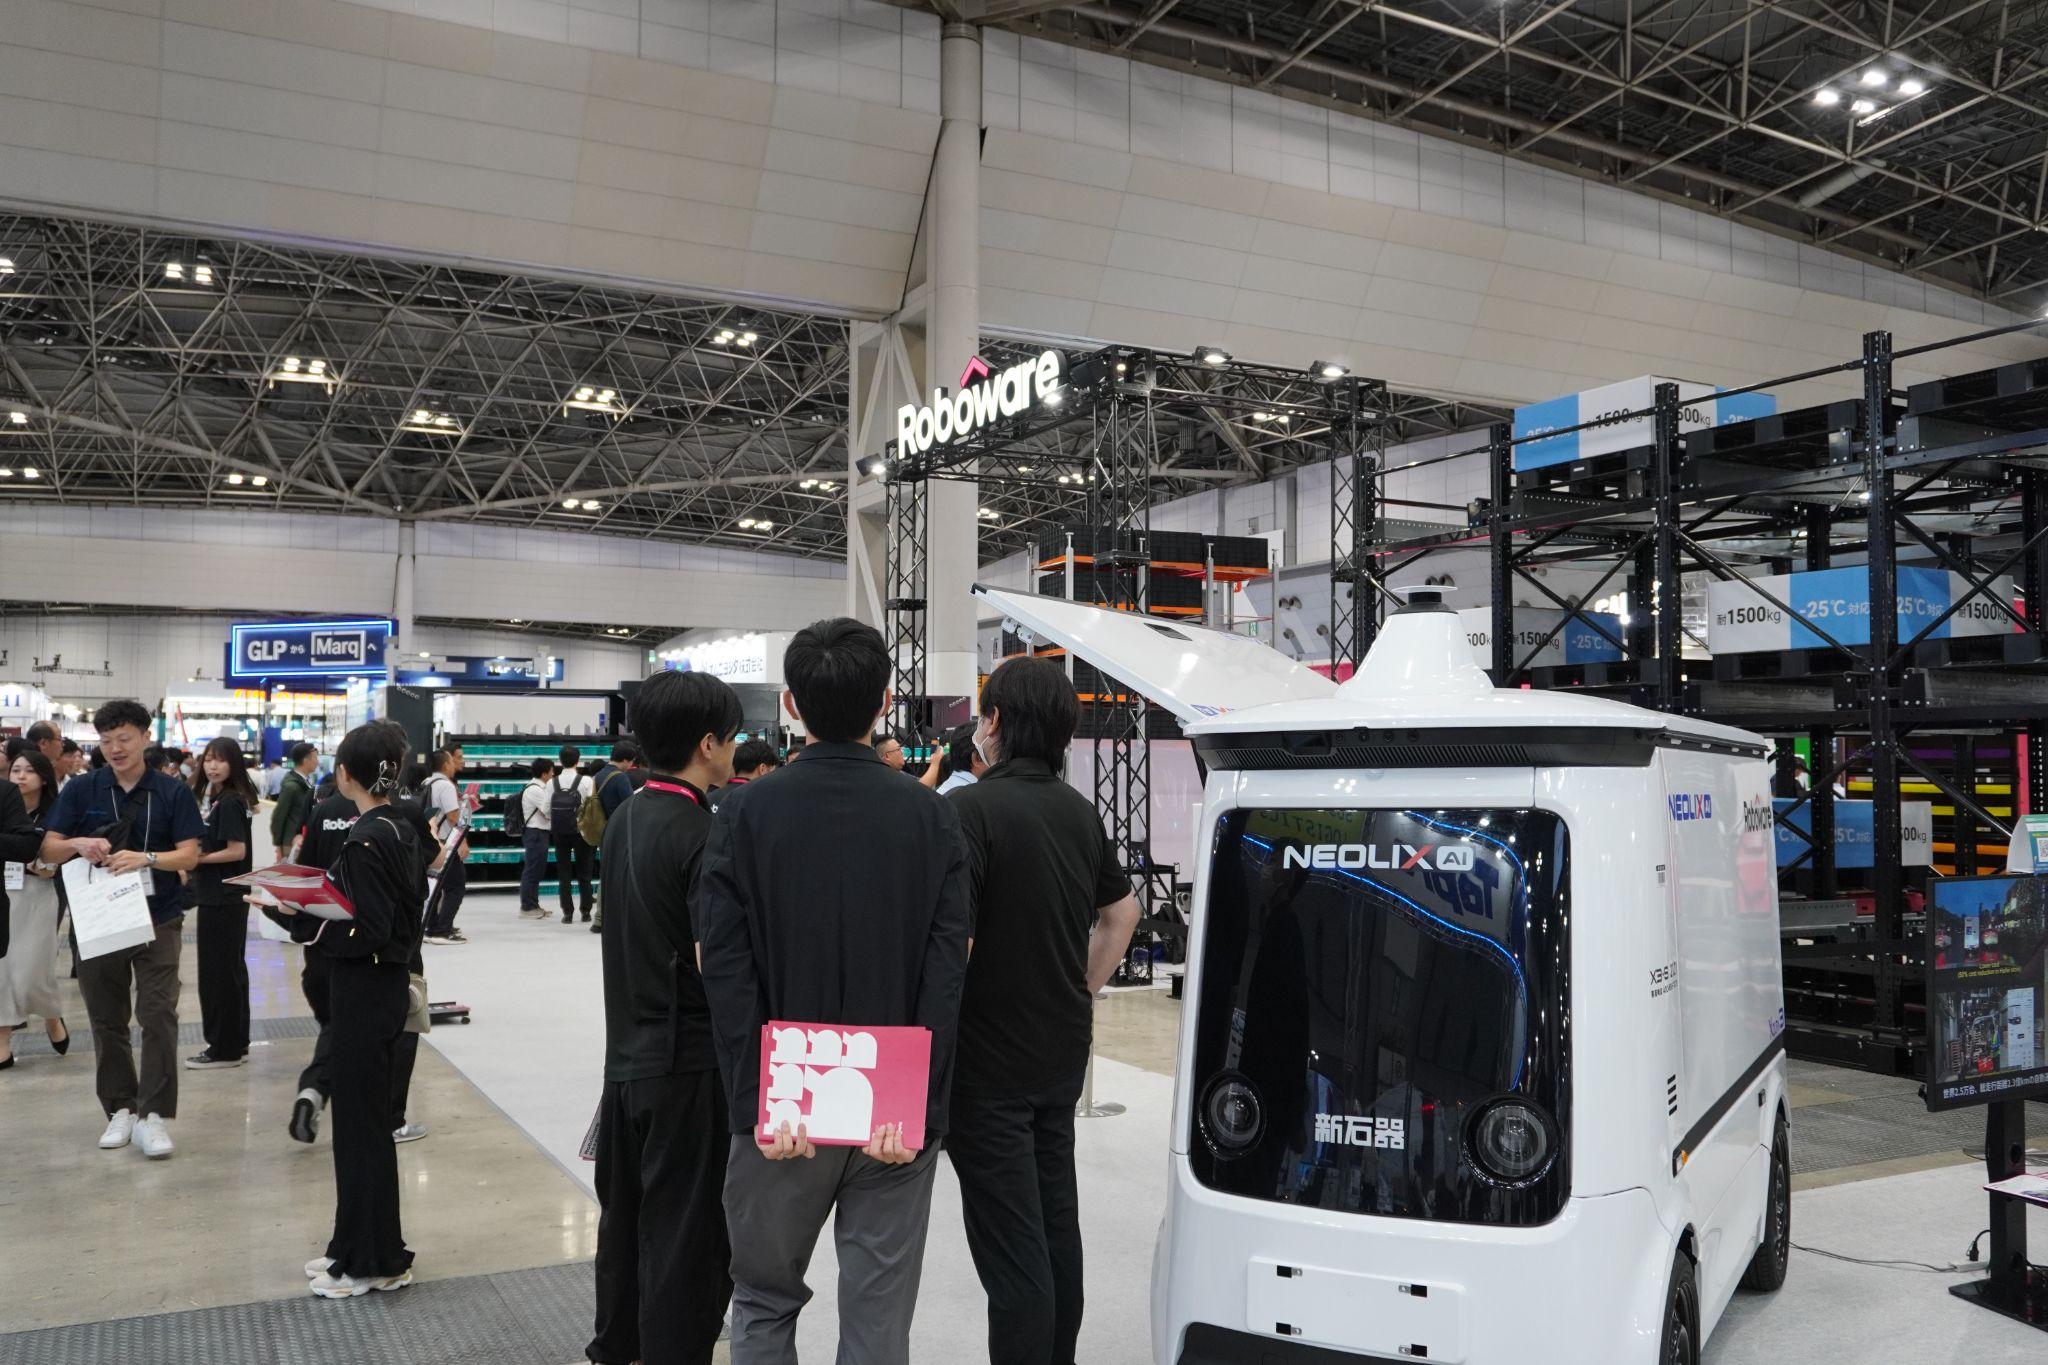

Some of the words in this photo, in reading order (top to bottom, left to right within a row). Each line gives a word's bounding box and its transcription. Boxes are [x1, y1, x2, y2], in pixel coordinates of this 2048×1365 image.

[898, 350, 1060, 460] Roboware
[248, 640, 288, 661] GLP
[290, 644, 305, 654] から
[316, 637, 359, 658] Marq
[1668, 794, 1704, 821] NEOLIX
[1743, 800, 1772, 832] Roboware
[1283, 844, 1434, 870] NEOLIX
[1314, 1113, 1405, 1150] 新石器
